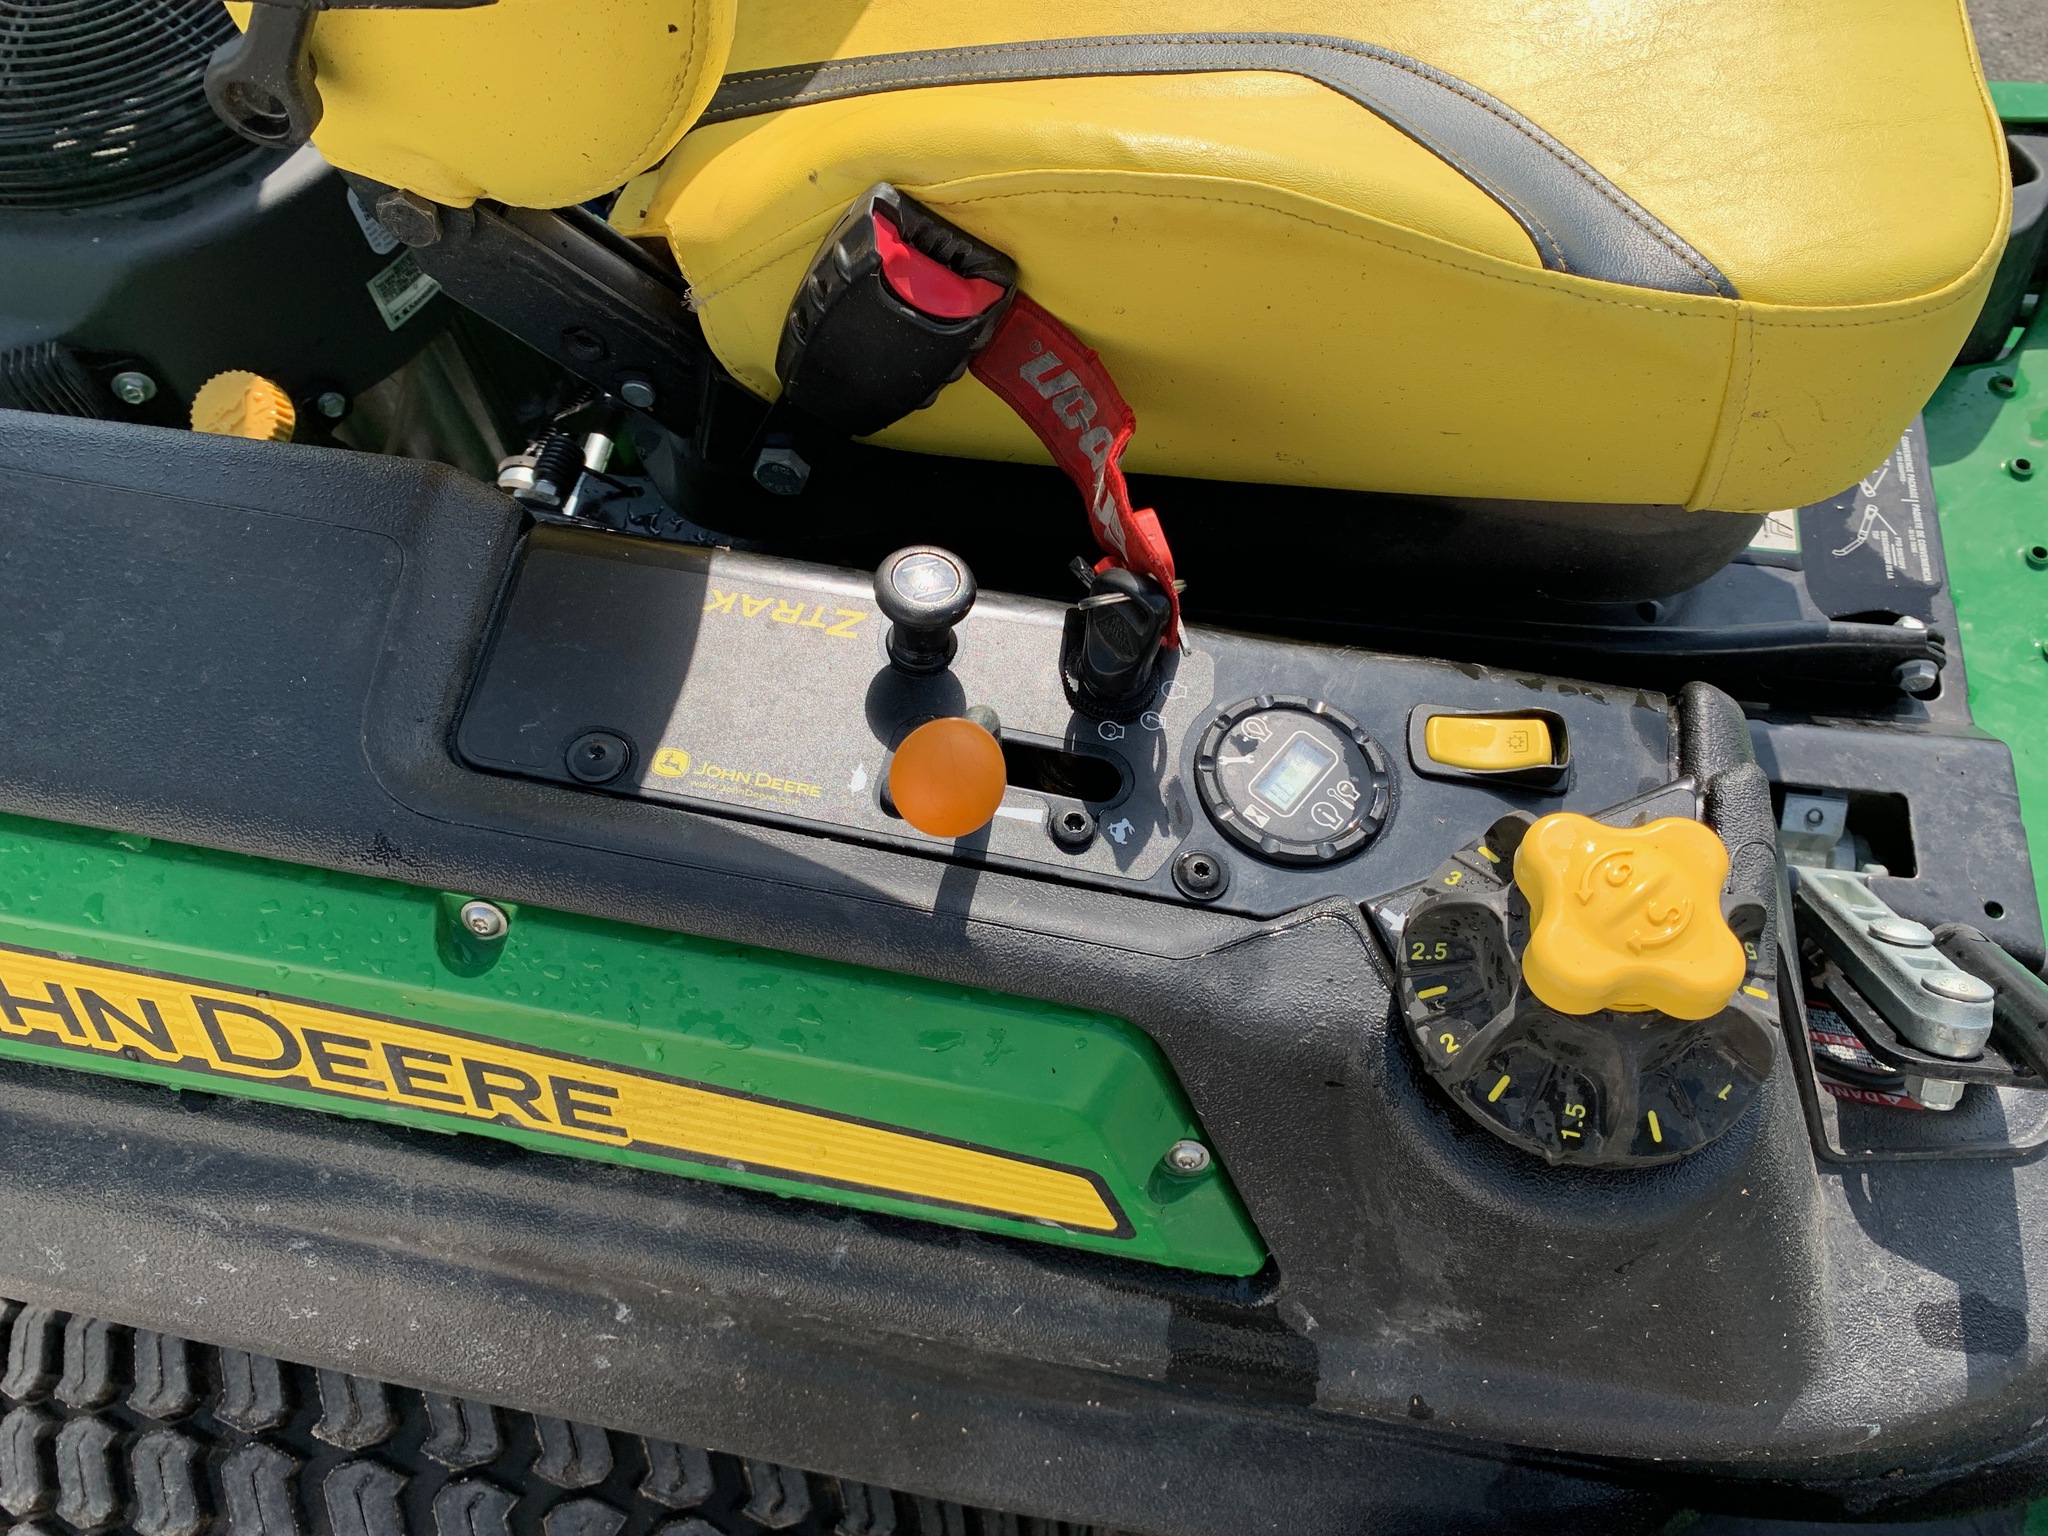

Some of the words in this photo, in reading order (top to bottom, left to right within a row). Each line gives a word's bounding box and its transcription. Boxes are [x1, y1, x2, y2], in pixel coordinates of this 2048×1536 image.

[1900, 435, 1914, 473] CONVENIENCE
[1905, 473, 1919, 499] PACKAGE
[1911, 504, 1924, 530] PAQUETE
[1915, 530, 1926, 538] DE
[1917, 539, 1932, 582] CONVENIENCIA
[703, 589, 869, 639] ZTRAK
[693, 761, 751, 785] JOHN
[755, 772, 823, 799] DEERE
[1443, 870, 1463, 886] 3
[1411, 941, 1448, 961] 2.5
[1438, 1032, 1460, 1054] 2
[191, 994, 630, 1138] DEERE
[1561, 1103, 1587, 1140] 1.5
